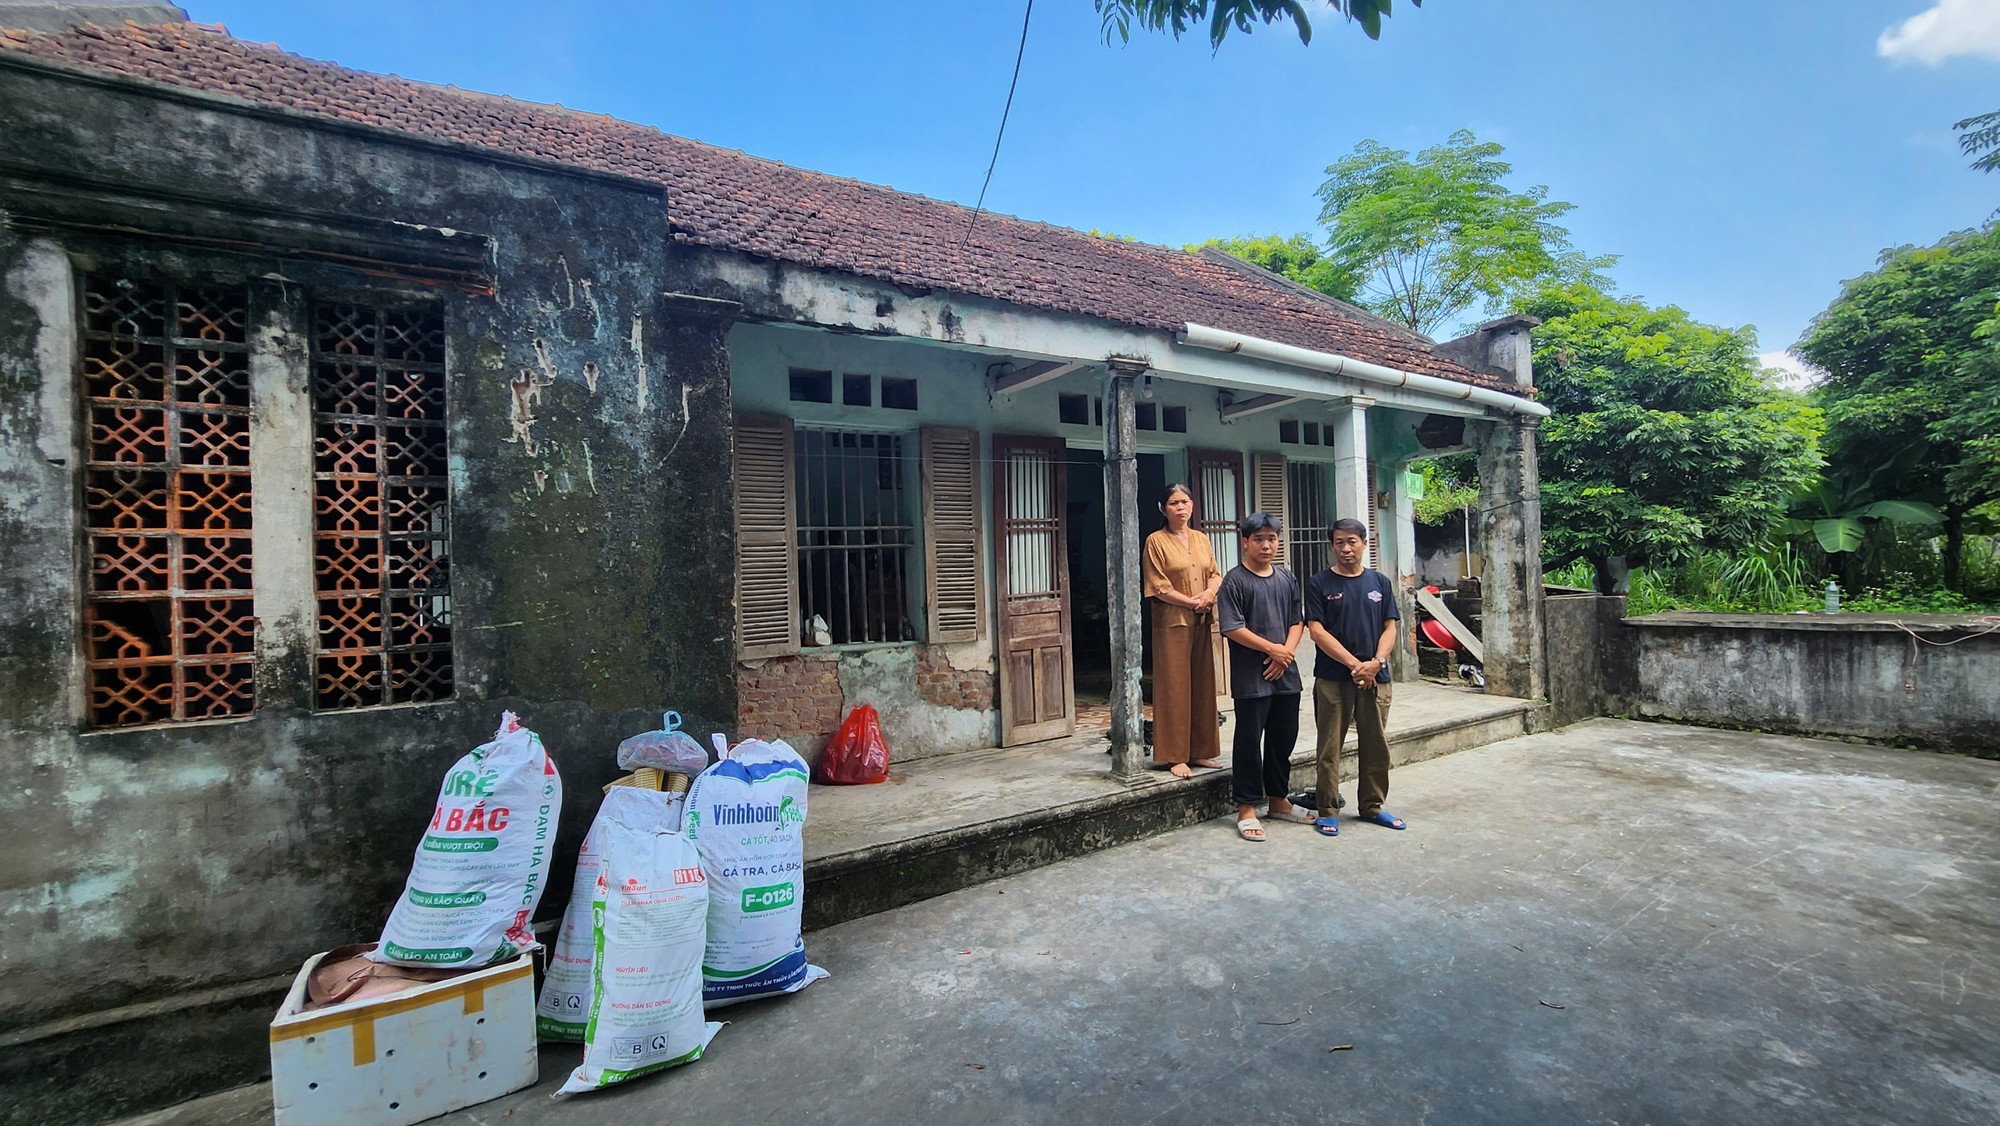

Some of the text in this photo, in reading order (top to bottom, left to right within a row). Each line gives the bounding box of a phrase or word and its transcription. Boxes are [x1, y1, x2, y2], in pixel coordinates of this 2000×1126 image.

[445, 801, 510, 832] BẮC
[714, 802, 779, 826] Vĩnhhoàn
[464, 841, 484, 850] TRỘI
[530, 846, 544, 868] HÀ
[723, 865, 739, 877] CÁ
[742, 866, 768, 876] TRA,
[771, 861, 784, 873] CÁ
[522, 873, 539, 905] BẮC
[745, 888, 793, 907] F-0126
[434, 896, 452, 905] BẢO
[454, 894, 484, 905] QUẢN
[404, 951, 422, 960] BÁO
[745, 981, 761, 989] THỨC
